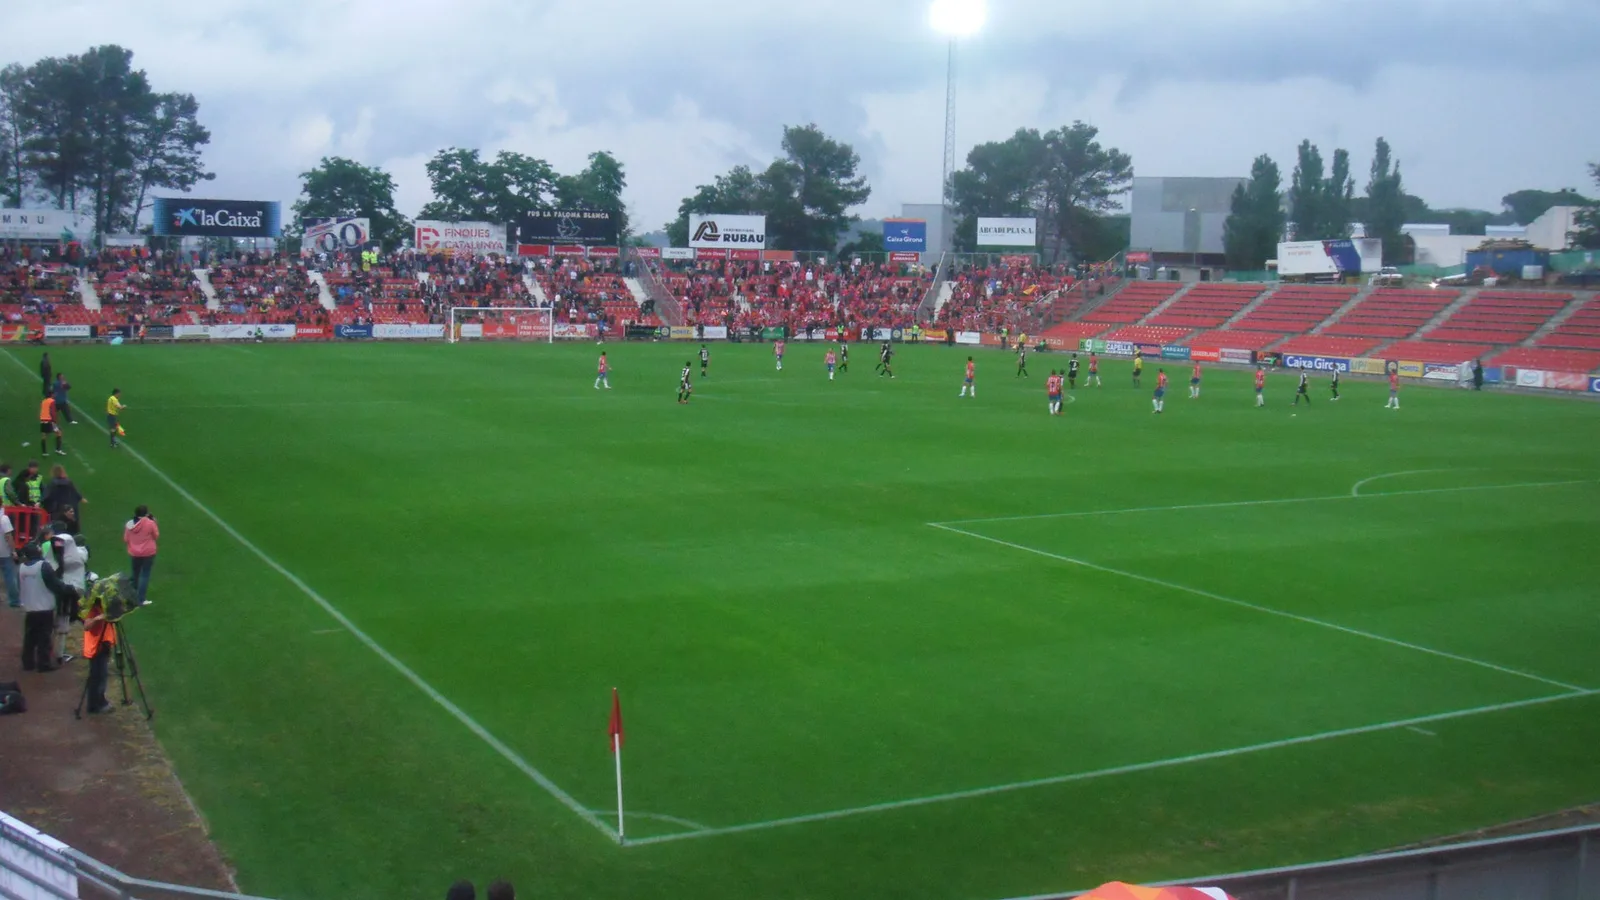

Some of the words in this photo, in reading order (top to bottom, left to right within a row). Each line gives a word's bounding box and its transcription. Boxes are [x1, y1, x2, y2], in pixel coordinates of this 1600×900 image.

[444, 228, 491, 238] FINQUES
[979, 226, 1006, 234] ARCADI
[722, 233, 765, 243] RUBAU
[887, 235, 903, 243] Caixa
[444, 240, 505, 250] CATALUNYA
[1106, 343, 1132, 351] CAPELLA
[1286, 356, 1313, 369] Caixa
